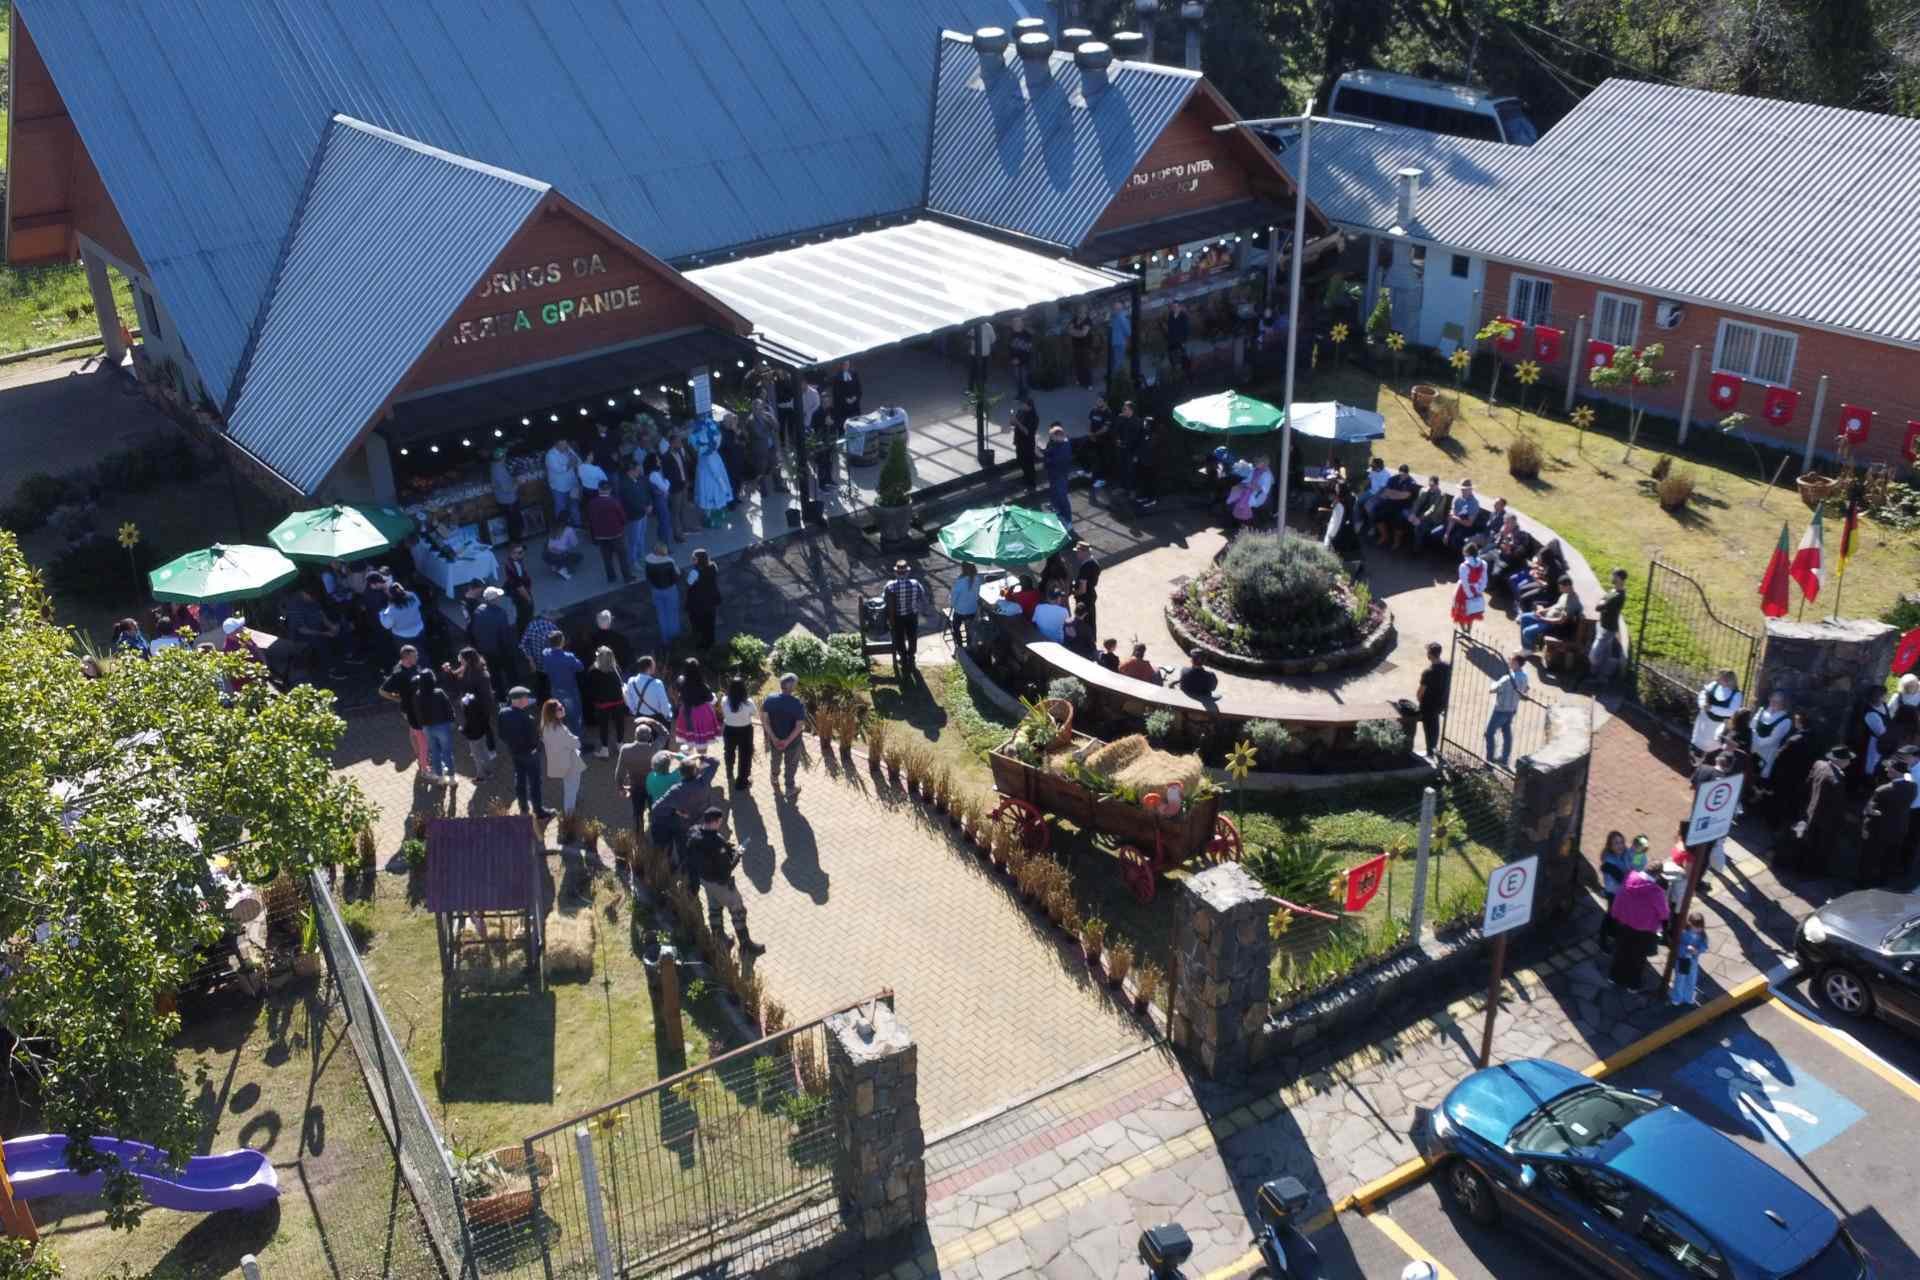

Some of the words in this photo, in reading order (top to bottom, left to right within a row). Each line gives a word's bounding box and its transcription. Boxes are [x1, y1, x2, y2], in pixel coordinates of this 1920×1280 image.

[572, 253, 607, 277] DA
[542, 285, 641, 325] GRANDE
[1711, 788, 1725, 805] E
[1506, 873, 1519, 891] E
